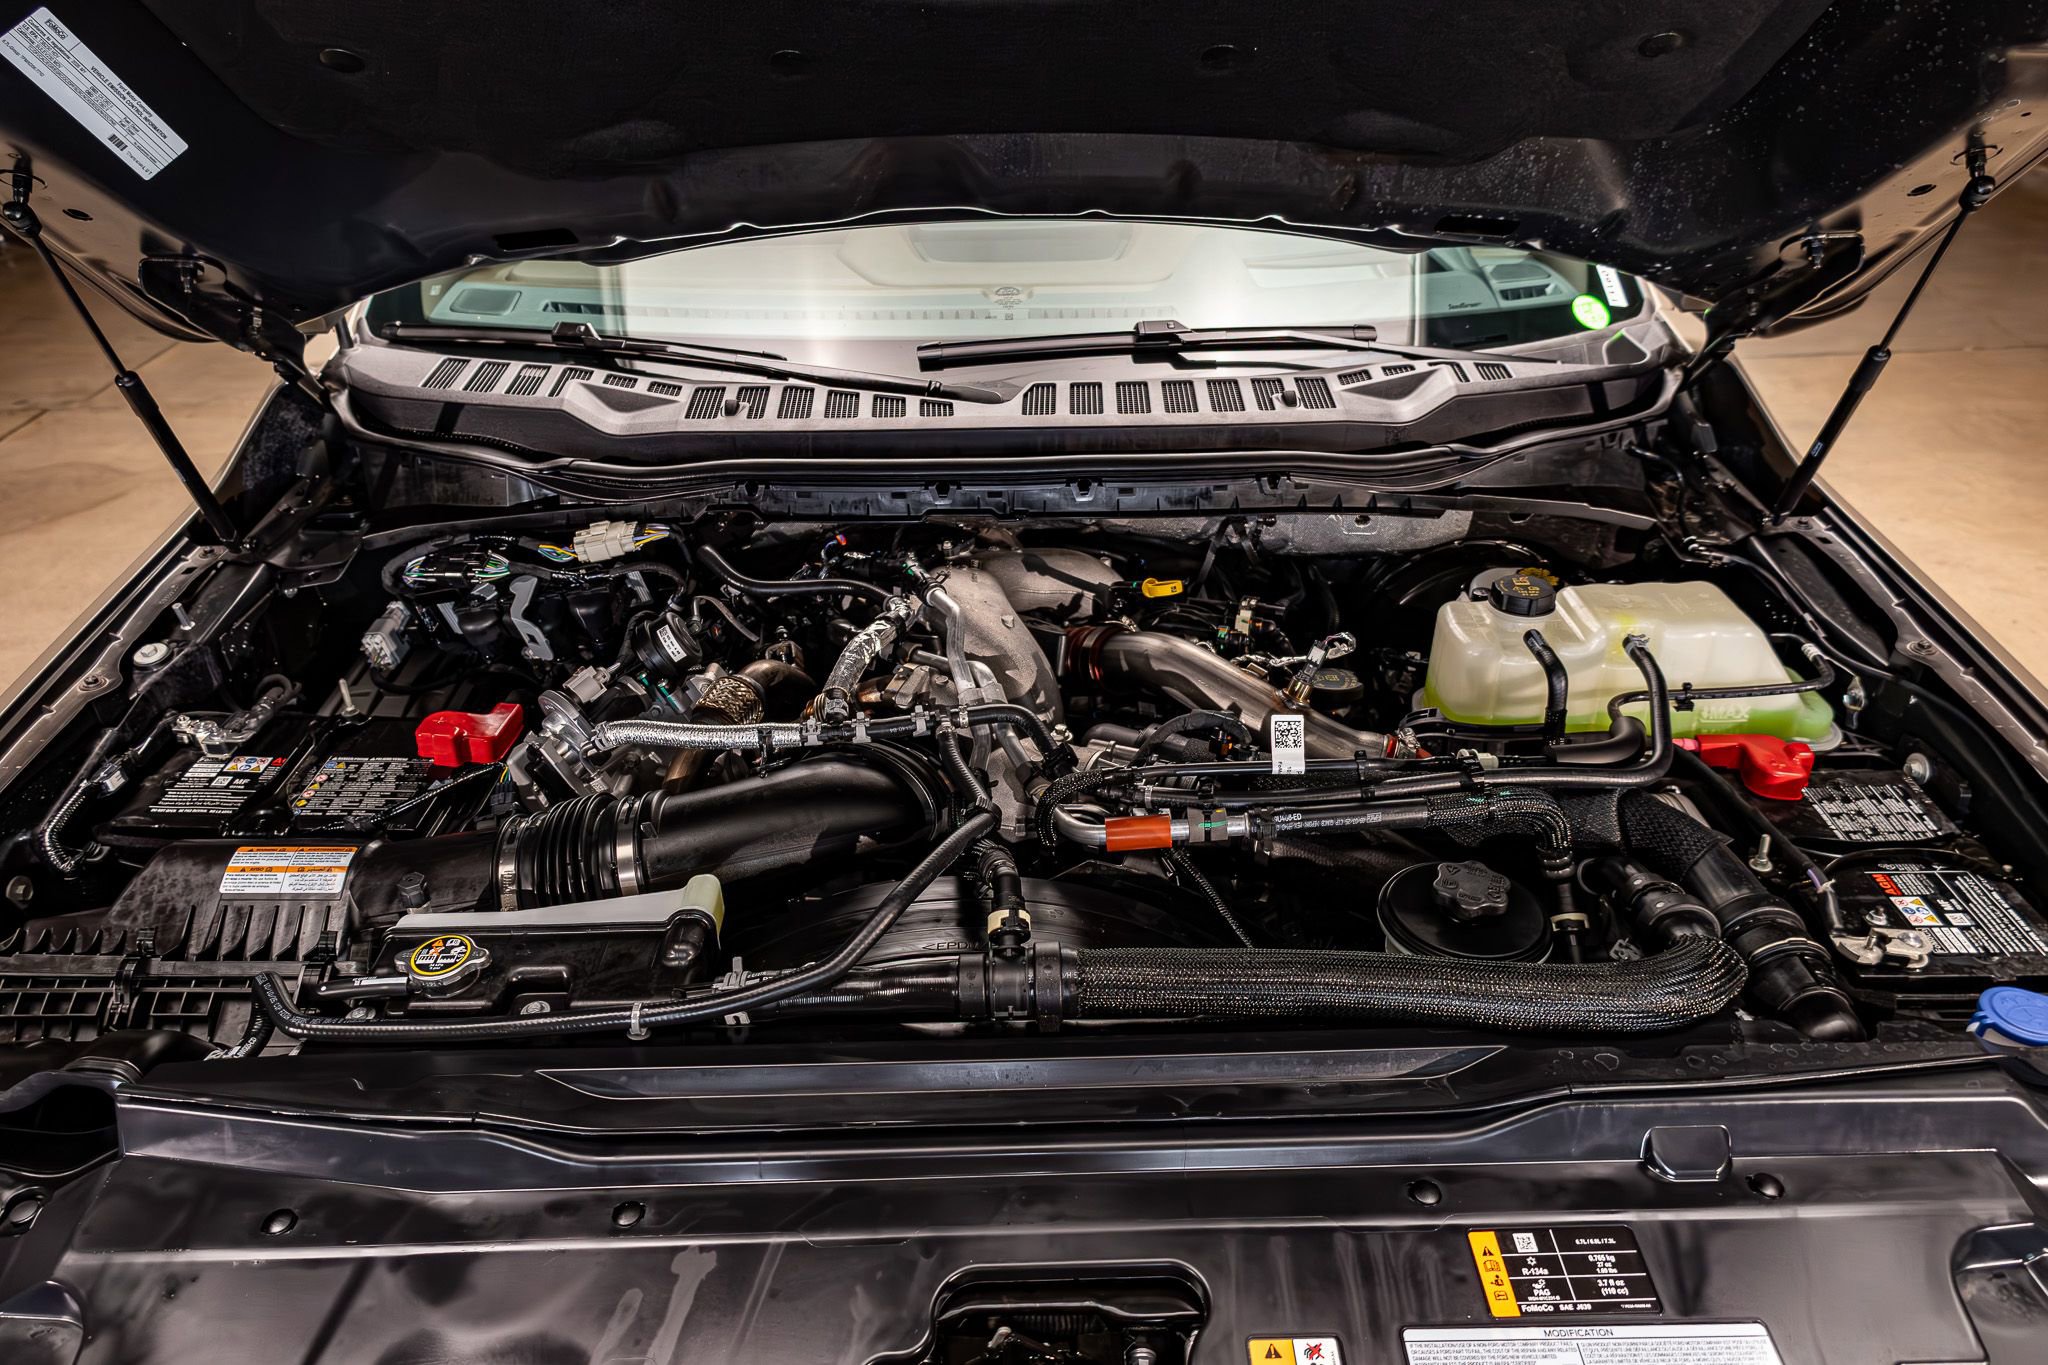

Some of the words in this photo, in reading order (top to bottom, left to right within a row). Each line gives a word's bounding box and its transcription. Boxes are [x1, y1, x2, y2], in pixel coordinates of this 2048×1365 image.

[89, 64, 109, 83] VEHICLE
[105, 80, 128, 101] EMISSION
[124, 98, 146, 118] CONTROL
[141, 114, 169, 140] INFORMATION
[1709, 705, 1751, 719] MAX
[1870, 873, 1898, 895] AGM
[1521, 1268, 1549, 1276] R-134a
[1596, 1279, 1608, 1287] 3.7
[1615, 1279, 1625, 1287] oz
[1533, 1288, 1551, 1297] PAG
[1521, 1304, 1554, 1312] FoMoCo
[1543, 1328, 1614, 1338] MODIFICATION
